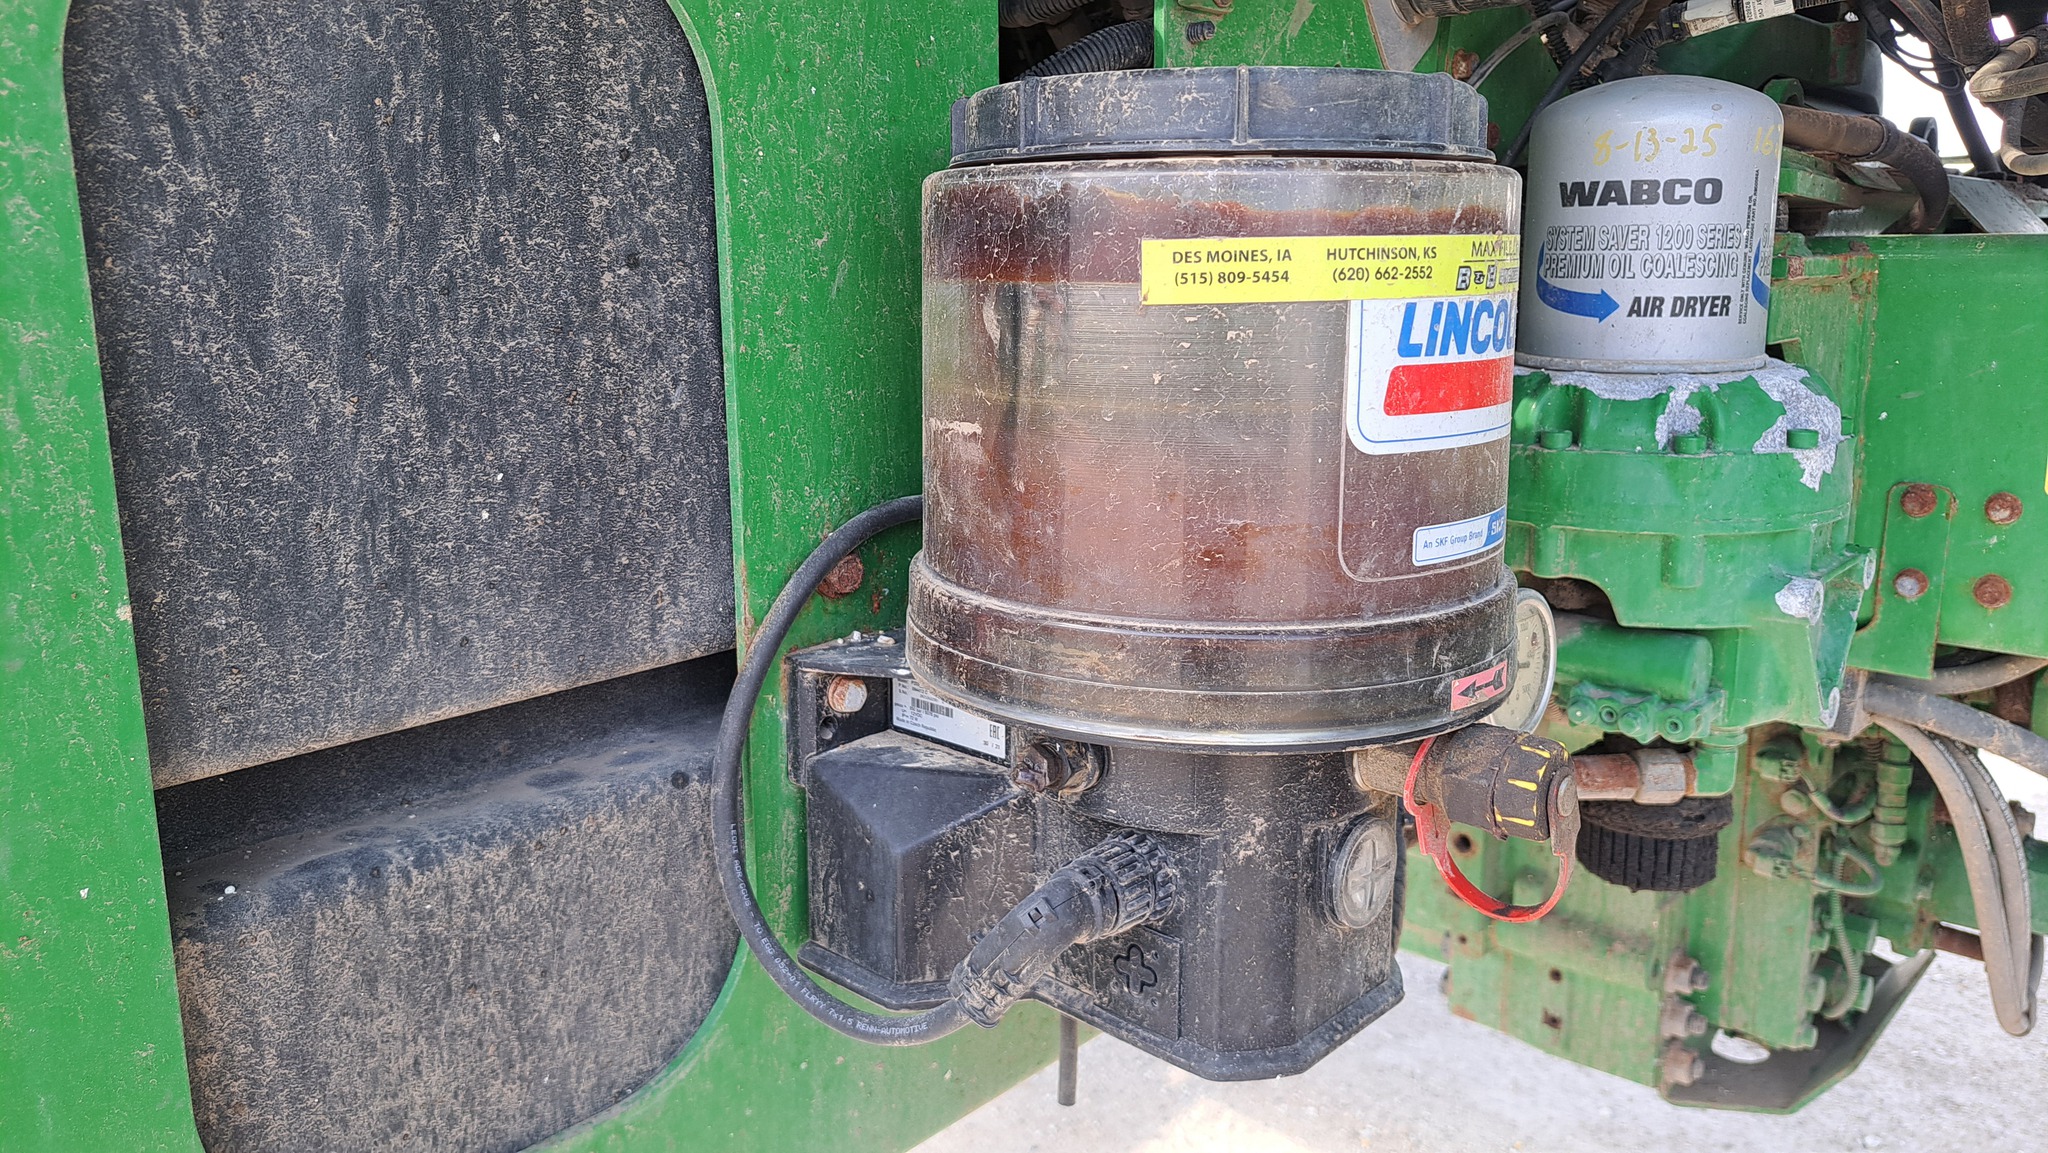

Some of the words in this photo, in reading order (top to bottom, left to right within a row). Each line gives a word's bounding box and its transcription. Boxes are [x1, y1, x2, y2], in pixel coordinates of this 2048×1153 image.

[1559, 177, 1723, 208] WABCO
[1546, 225, 1596, 251] SYSTEM
[1599, 224, 1650, 250] SAVER
[1655, 223, 1693, 250] 1200
[1697, 223, 1742, 249] SERIES
[1172, 250, 1202, 264] DES
[1206, 249, 1272, 264] MOINES,
[1277, 249, 1292, 262] IA
[1327, 246, 1420, 261] HUTCHINSON,
[1423, 246, 1437, 259] KS
[1332, 267, 1370, 283] (620)
[1374, 265, 1433, 280] 662-2552
[1544, 253, 1604, 279] PREMIUM
[1608, 253, 1635, 279] OIL
[1640, 252, 1738, 278] COALESCING
[1174, 271, 1213, 286] (515)
[1217, 270, 1290, 284] 809-5454
[1626, 295, 1665, 318] AIR
[1670, 295, 1731, 318] DRYER
[1423, 540, 1433, 550] An
[1435, 536, 1449, 548] SKF
[1450, 533, 1468, 545] Group
[1469, 529, 1483, 541] Brand
[856, 1021, 929, 1036] RENN-AUTOMOTIVE
